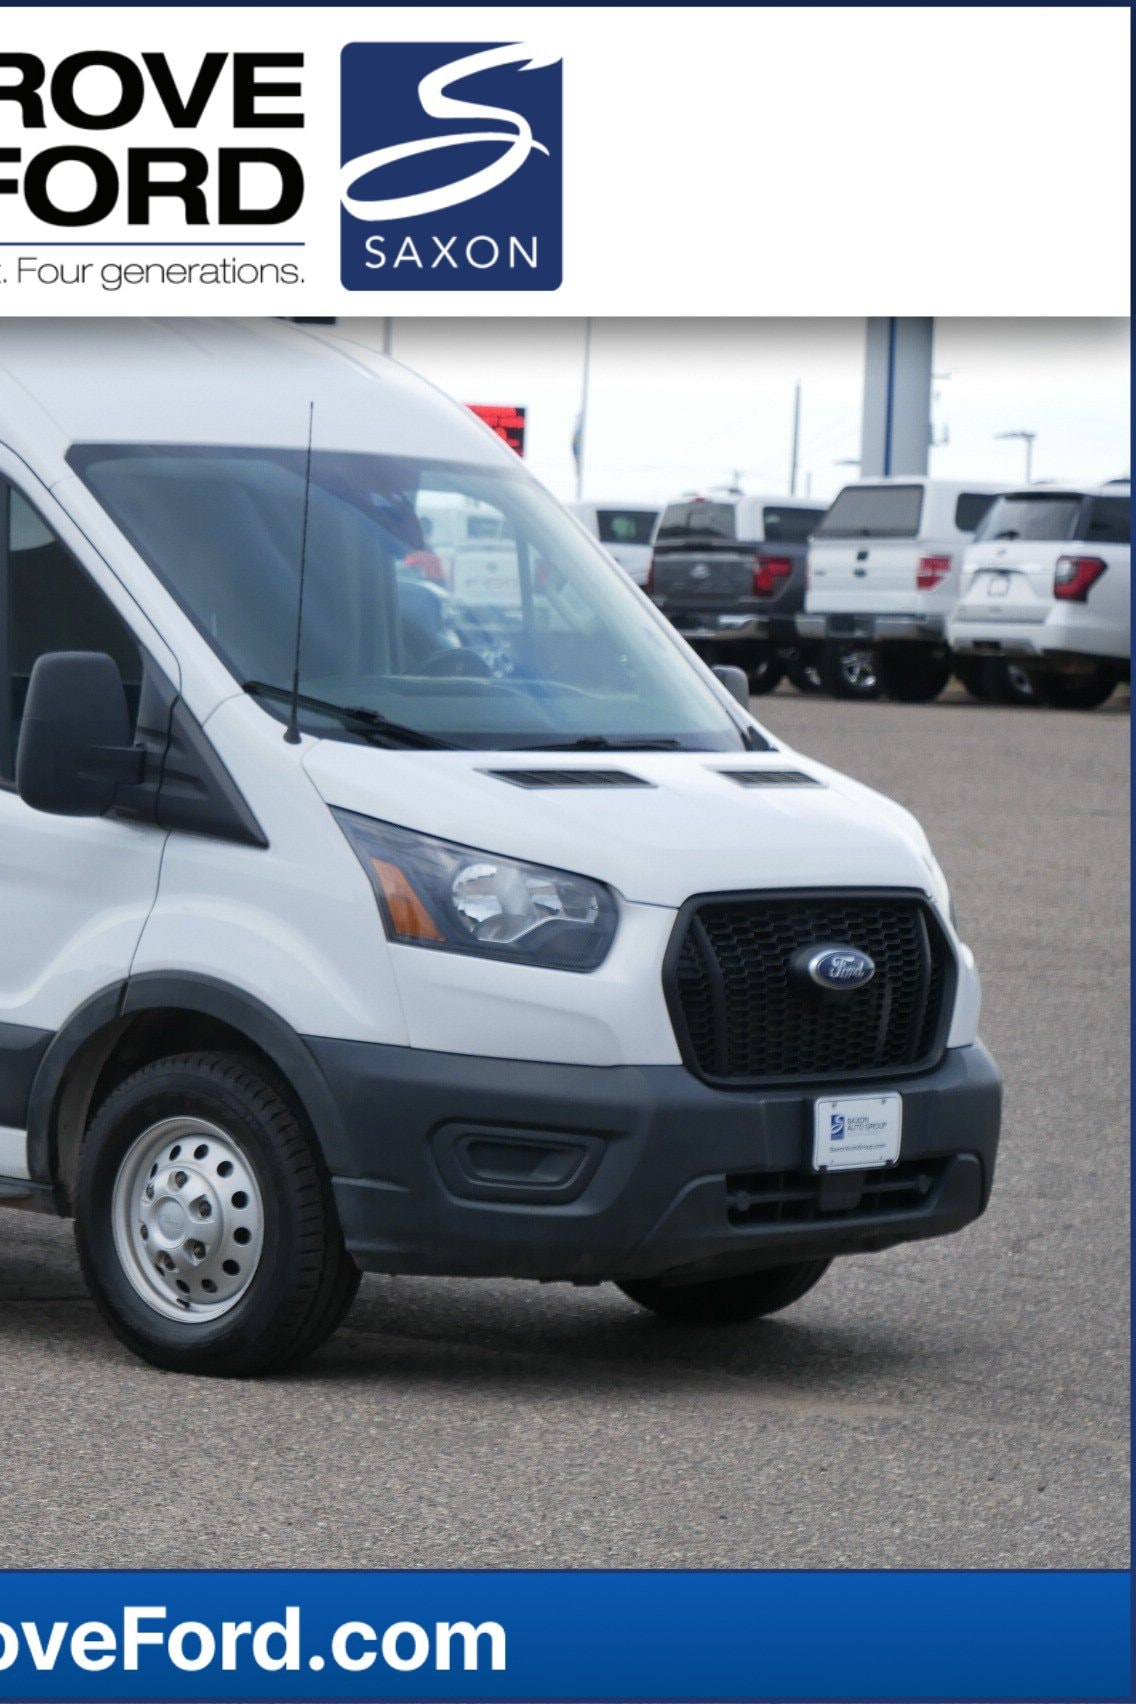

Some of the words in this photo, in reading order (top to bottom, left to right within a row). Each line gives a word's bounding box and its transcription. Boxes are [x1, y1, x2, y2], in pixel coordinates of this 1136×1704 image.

[829, 955, 865, 978] Ford
[847, 1115, 870, 1124] SAXON
[847, 1123, 864, 1131] AUTO
[865, 1122, 888, 1130] GROUP
